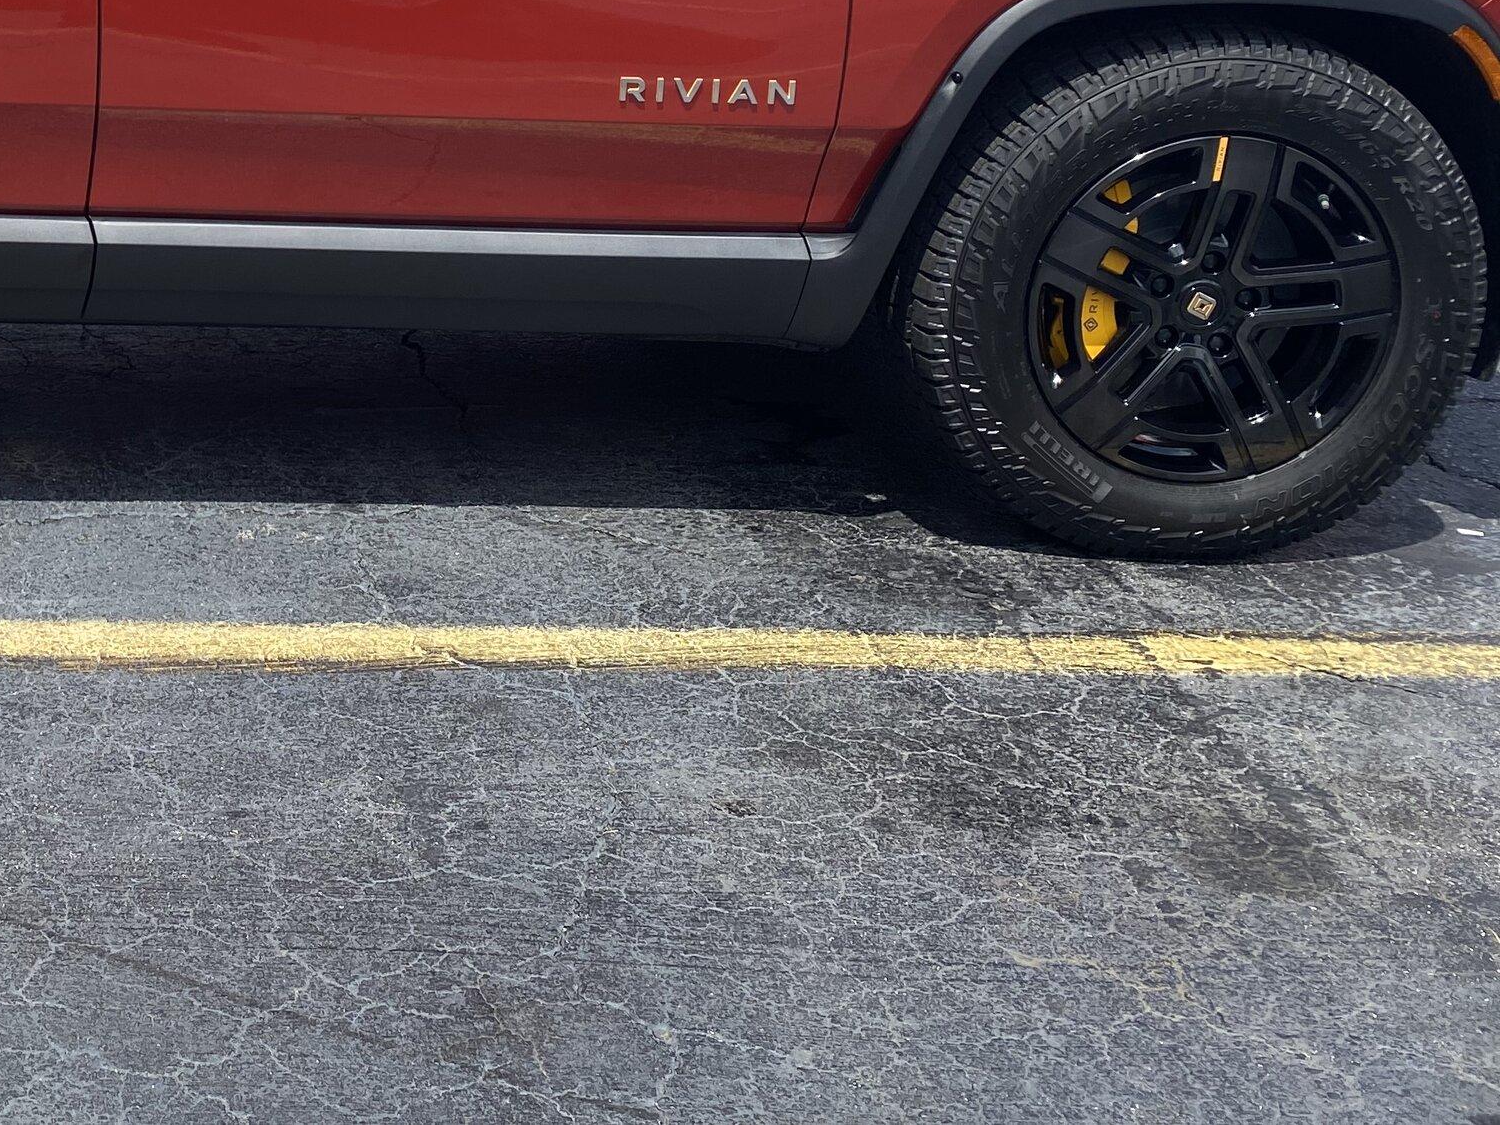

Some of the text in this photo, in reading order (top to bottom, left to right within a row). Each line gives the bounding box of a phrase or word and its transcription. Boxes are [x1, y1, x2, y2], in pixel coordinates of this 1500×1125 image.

[618, 76, 797, 106] RIVIAN
[1391, 176, 1435, 231] R20
[1020, 419, 1114, 504] PIRELLI
